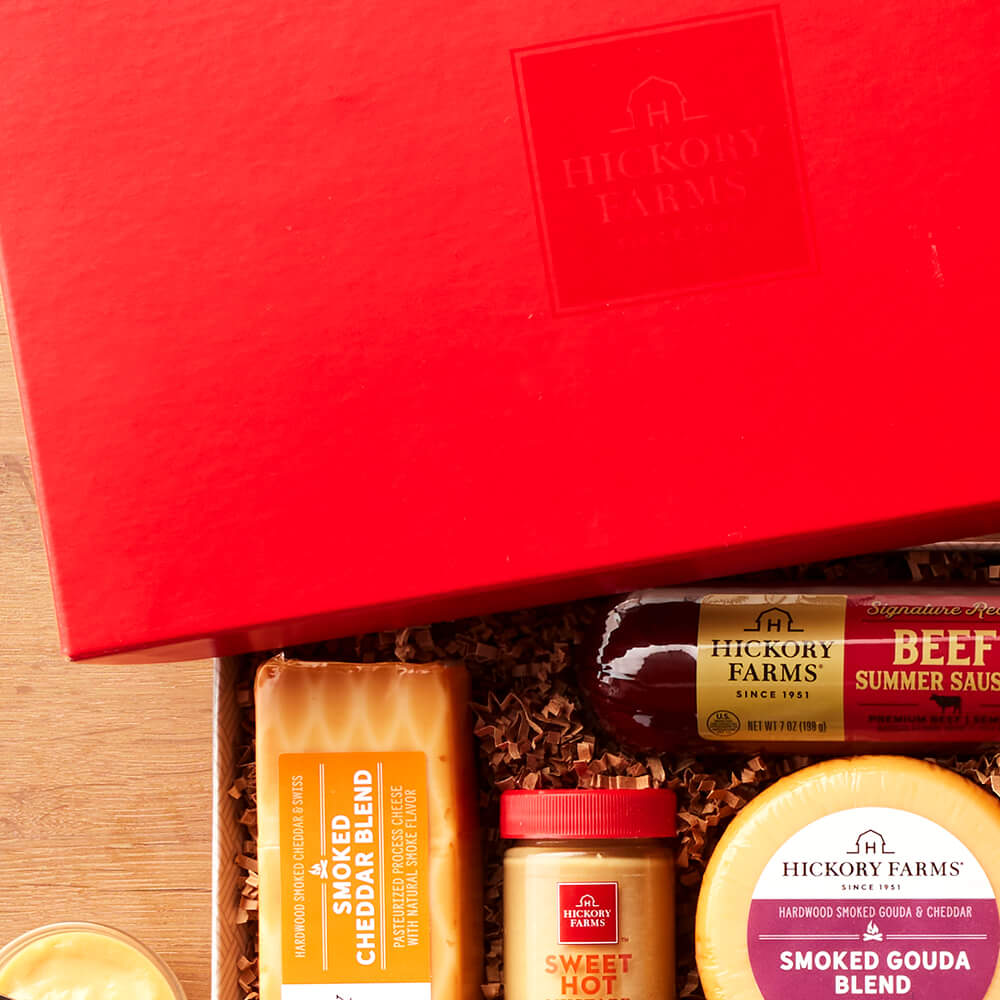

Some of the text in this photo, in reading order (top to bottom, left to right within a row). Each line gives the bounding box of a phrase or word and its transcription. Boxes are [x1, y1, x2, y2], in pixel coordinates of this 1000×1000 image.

[647, 100, 669, 127] H
[562, 125, 766, 188] HICKORY
[595, 172, 747, 223] FARMS
[867, 601, 962, 619] Signature
[767, 619, 781, 632] H
[712, 640, 834, 658] HICKORY
[893, 629, 997, 666] BEEF
[728, 664, 818, 683] FARMS
[855, 670, 943, 691] SUMMER
[783, 691, 809, 699] 1951
[747, 720, 762, 731] NET
[765, 720, 777, 731] WT
[786, 720, 797, 731] OZ
[292, 775, 304, 805] SWISS
[292, 817, 304, 861] CHEDDAR
[865, 842, 876, 854] H
[332, 815, 352, 915] SMOKED
[353, 769, 376, 965] CHEDDAR BLEND
[390, 785, 405, 948] PASTEURIZED PROCESS CHEESE
[405, 789, 419, 946] WITH NATURAL SMOKE FLAVOR
[783, 861, 959, 877] HICKORY FARMS
[293, 863, 305, 903] SMOKED
[563, 909, 611, 918] HICKORY
[779, 906, 972, 918] HARDWOOD SMOKED GOUDA & CHEDDAR
[294, 904, 306, 958] HARDWOOD
[570, 918, 606, 927] FARMS
[545, 953, 633, 974] SWEET
[780, 951, 971, 970] SMOKED GOUDA
[561, 975, 617, 995] HOT
[835, 976, 911, 994] BLEND
